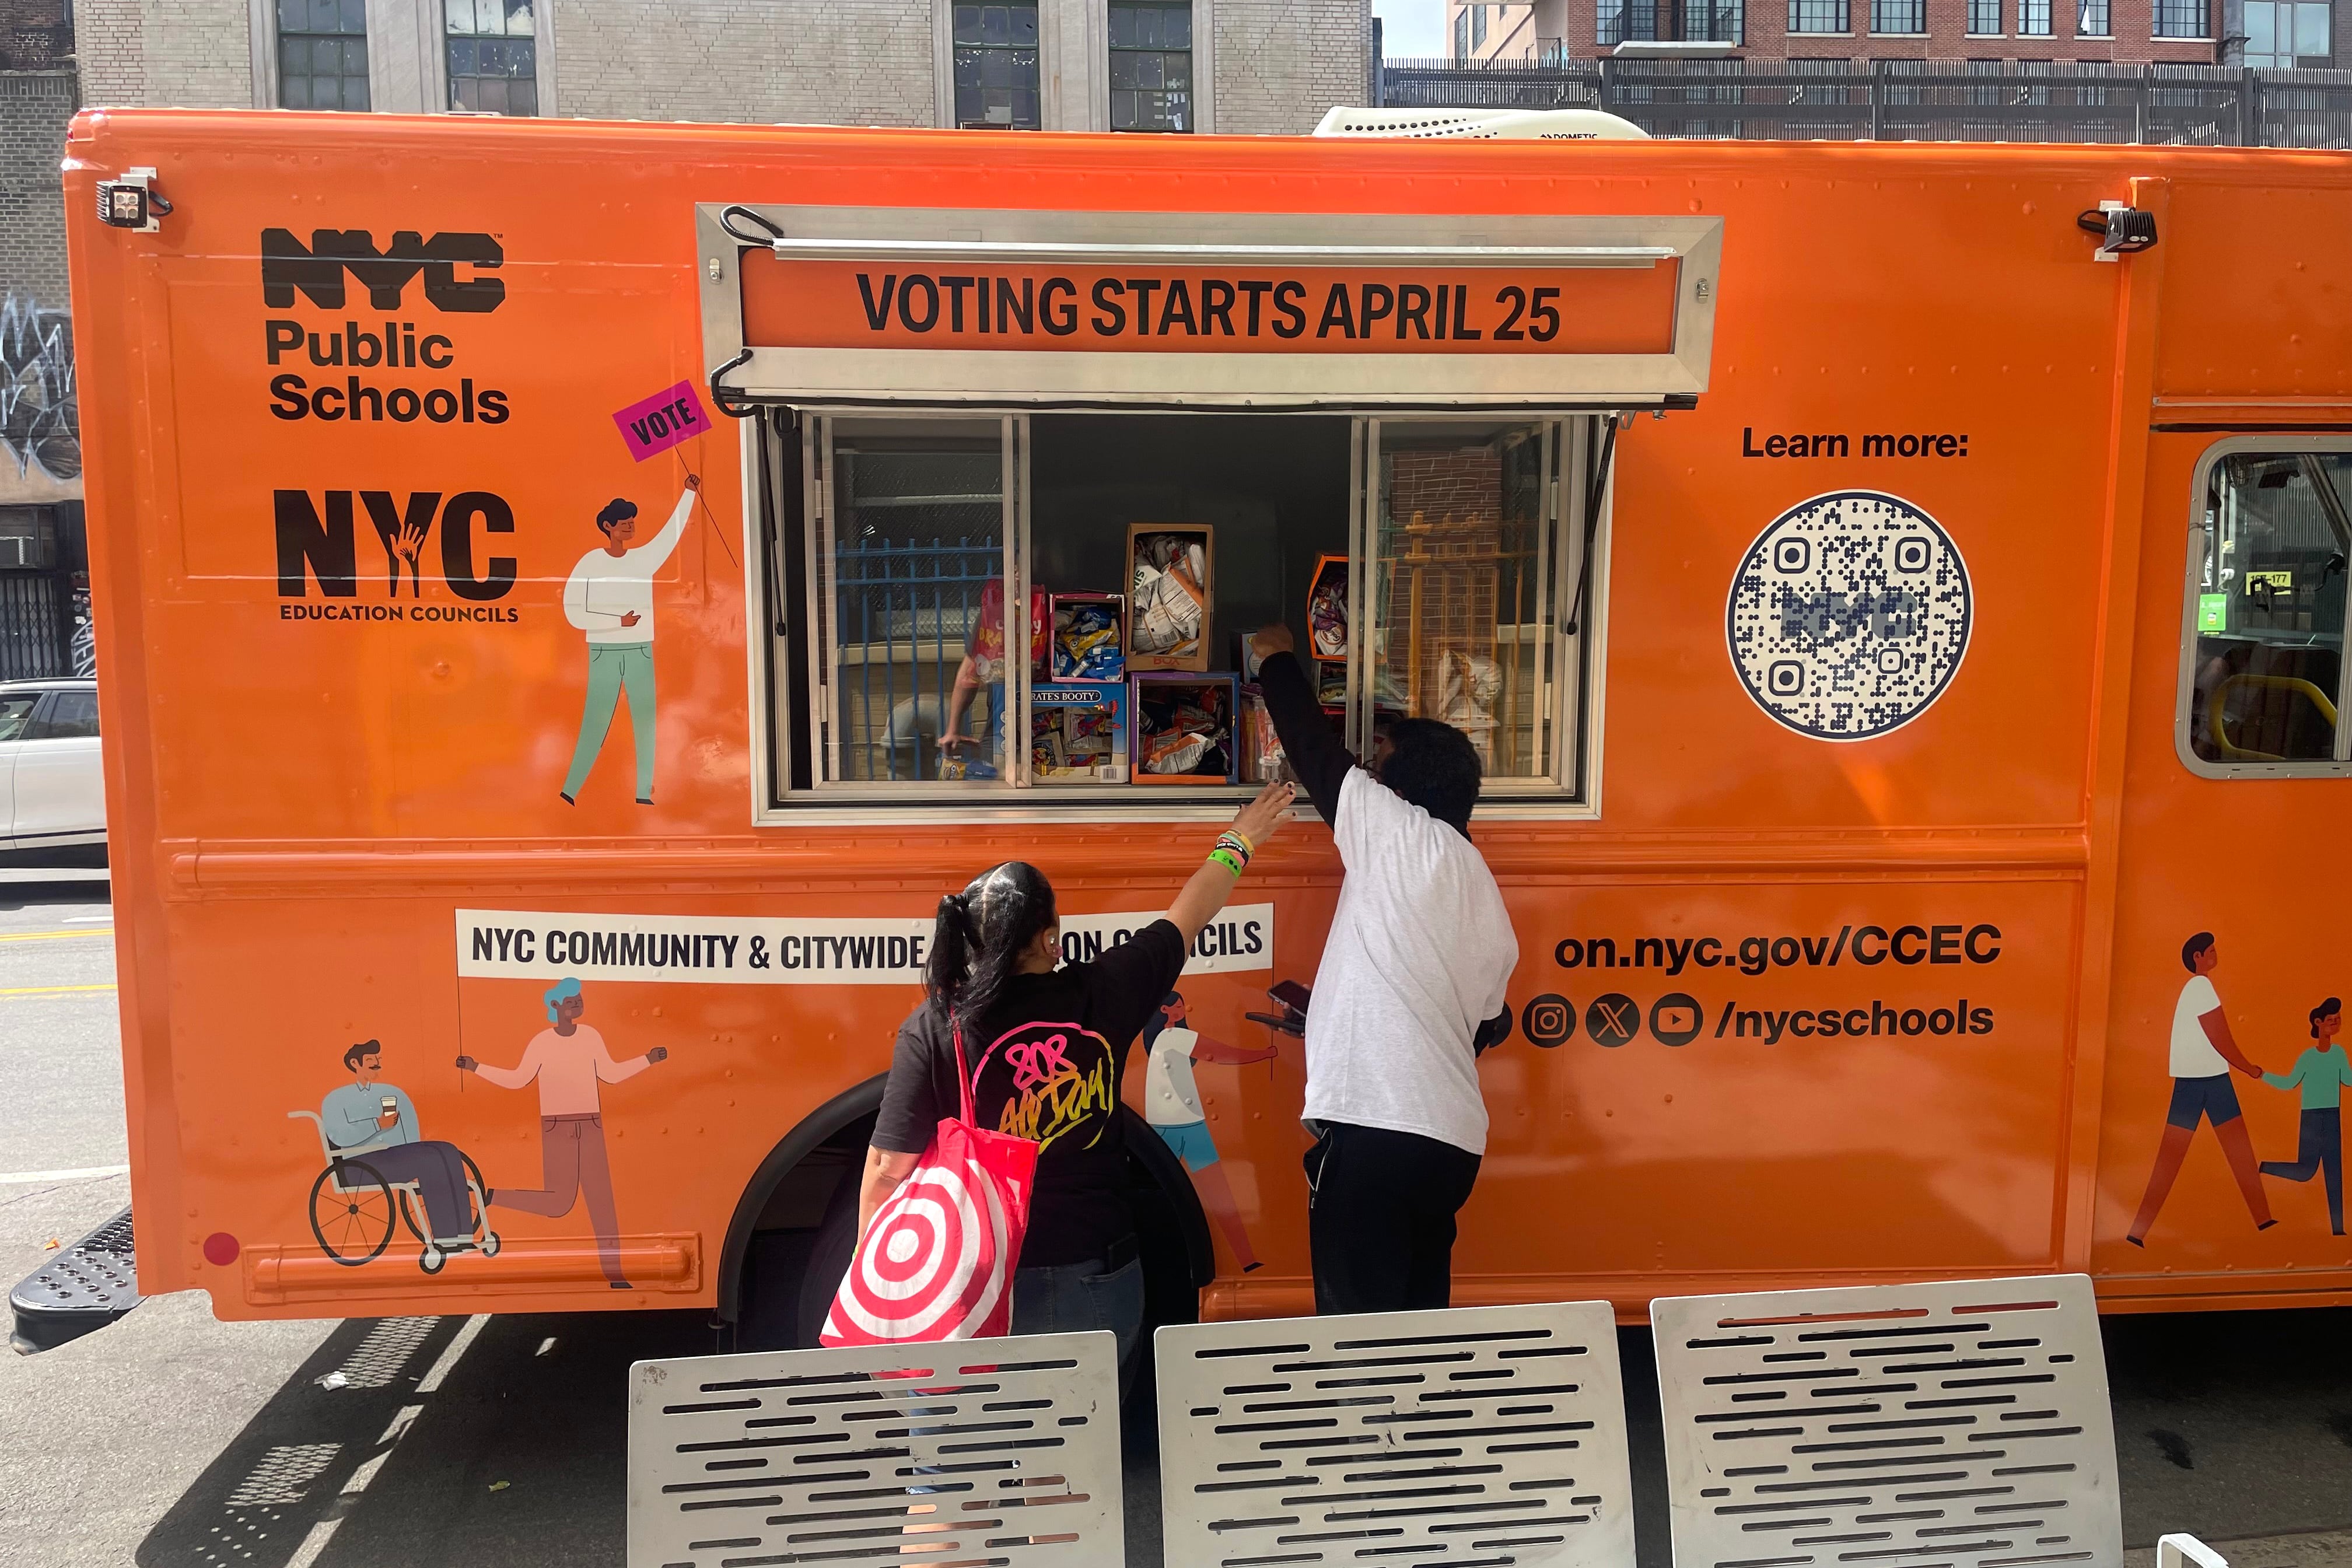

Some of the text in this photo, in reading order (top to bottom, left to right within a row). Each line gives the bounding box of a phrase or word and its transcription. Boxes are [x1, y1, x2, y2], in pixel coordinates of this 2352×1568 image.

[261, 228, 506, 313] NYC
[856, 274, 1560, 341] VOTING STARTS APRIL 25
[265, 320, 454, 369] Public
[270, 374, 510, 424] Schools
[630, 397, 696, 445] VOTE
[1743, 427, 1969, 457] Learn more:
[274, 489, 517, 600] NYC
[280, 605, 519, 622] EDUCATION COUNCILS
[1031, 692, 1094, 701] RATE'S BOOTY
[473, 927, 535, 963] NYC
[546, 930, 739, 968] COMMUNITY
[749, 935, 769, 969] &
[780, 936, 925, 969] CITYWIDE
[1555, 924, 2001, 976] on.nyc.gov/CCEC
[1714, 999, 1994, 1045] /nycschools
